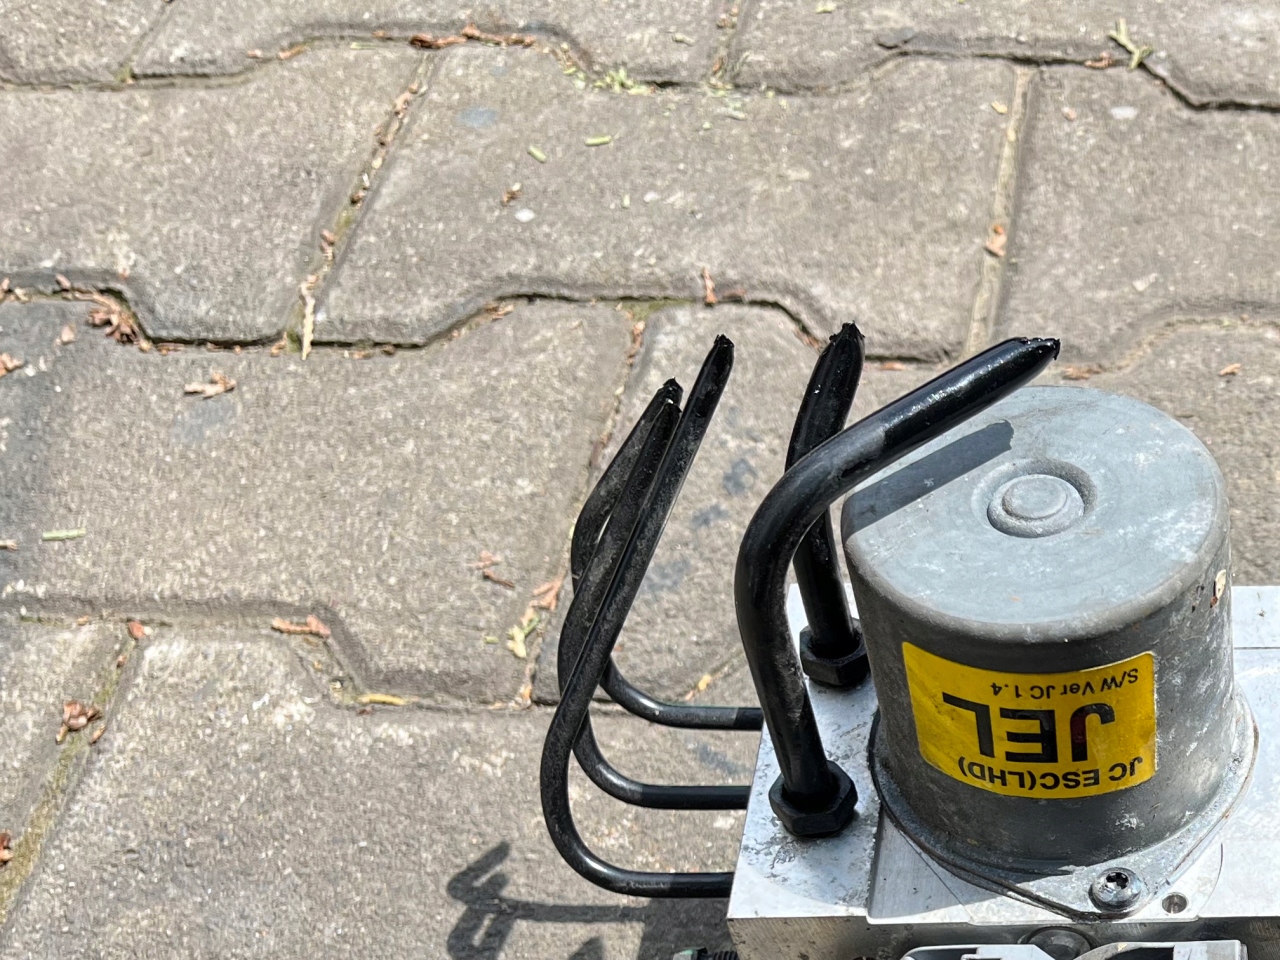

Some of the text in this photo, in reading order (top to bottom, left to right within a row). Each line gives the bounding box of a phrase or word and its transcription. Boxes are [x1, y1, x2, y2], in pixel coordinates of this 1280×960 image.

[990, 668, 1139, 699] S/W Ver JC 1.4
[942, 691, 1116, 763] JEL
[958, 757, 1144, 790] JC ESC(LHD)
